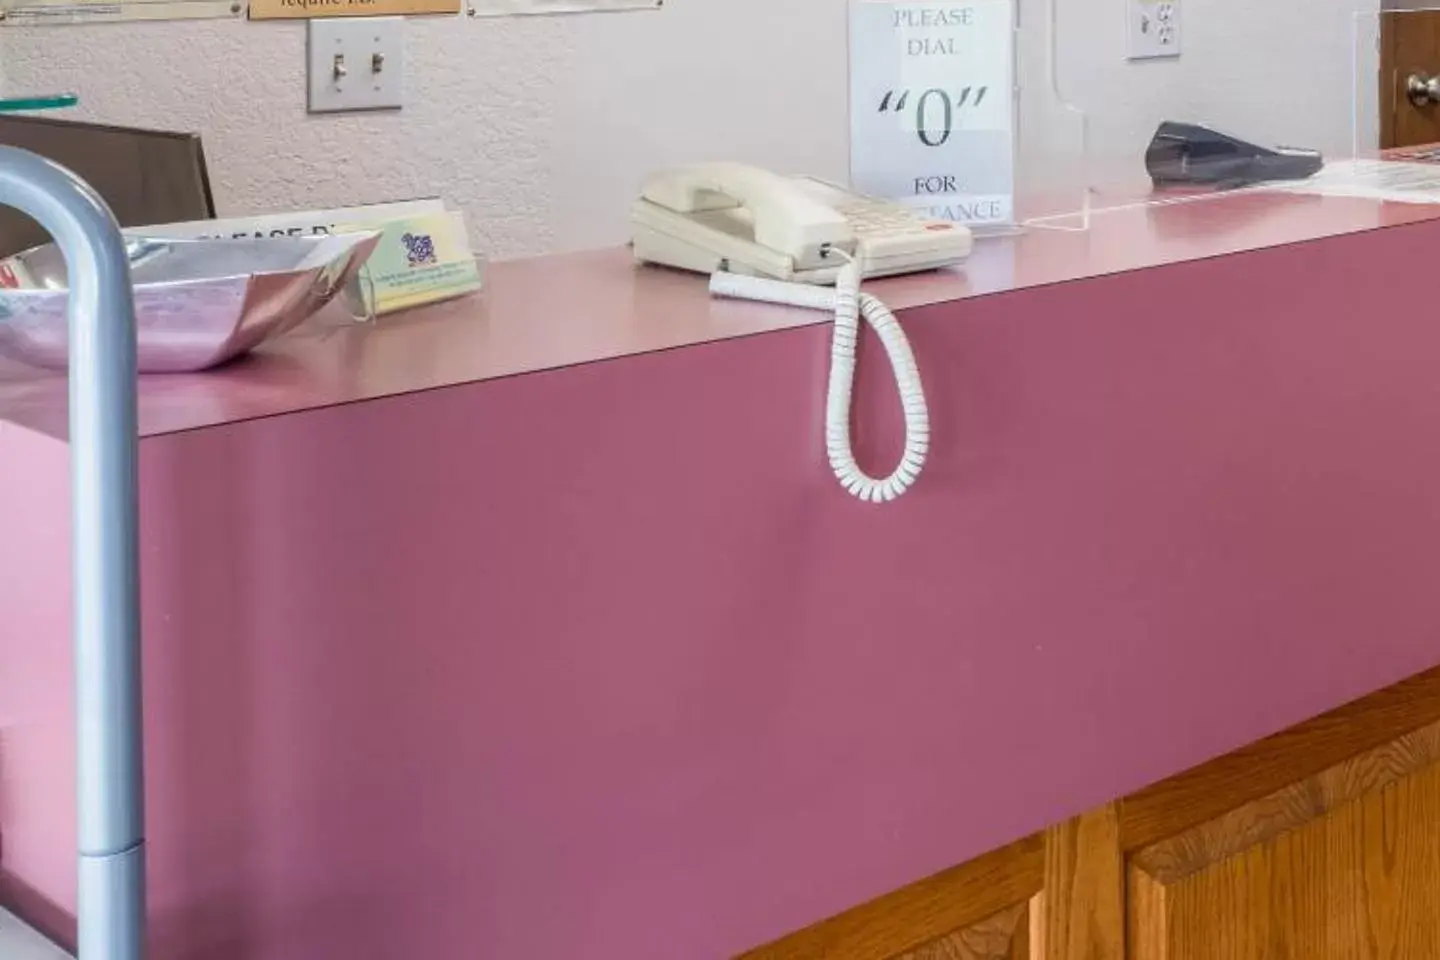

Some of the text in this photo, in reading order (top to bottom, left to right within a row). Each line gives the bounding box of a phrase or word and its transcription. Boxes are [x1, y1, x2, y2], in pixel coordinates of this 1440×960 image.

[893, 7, 974, 28] PLEASE
[907, 37, 961, 56] DIAL
[914, 175, 958, 195] FOR
